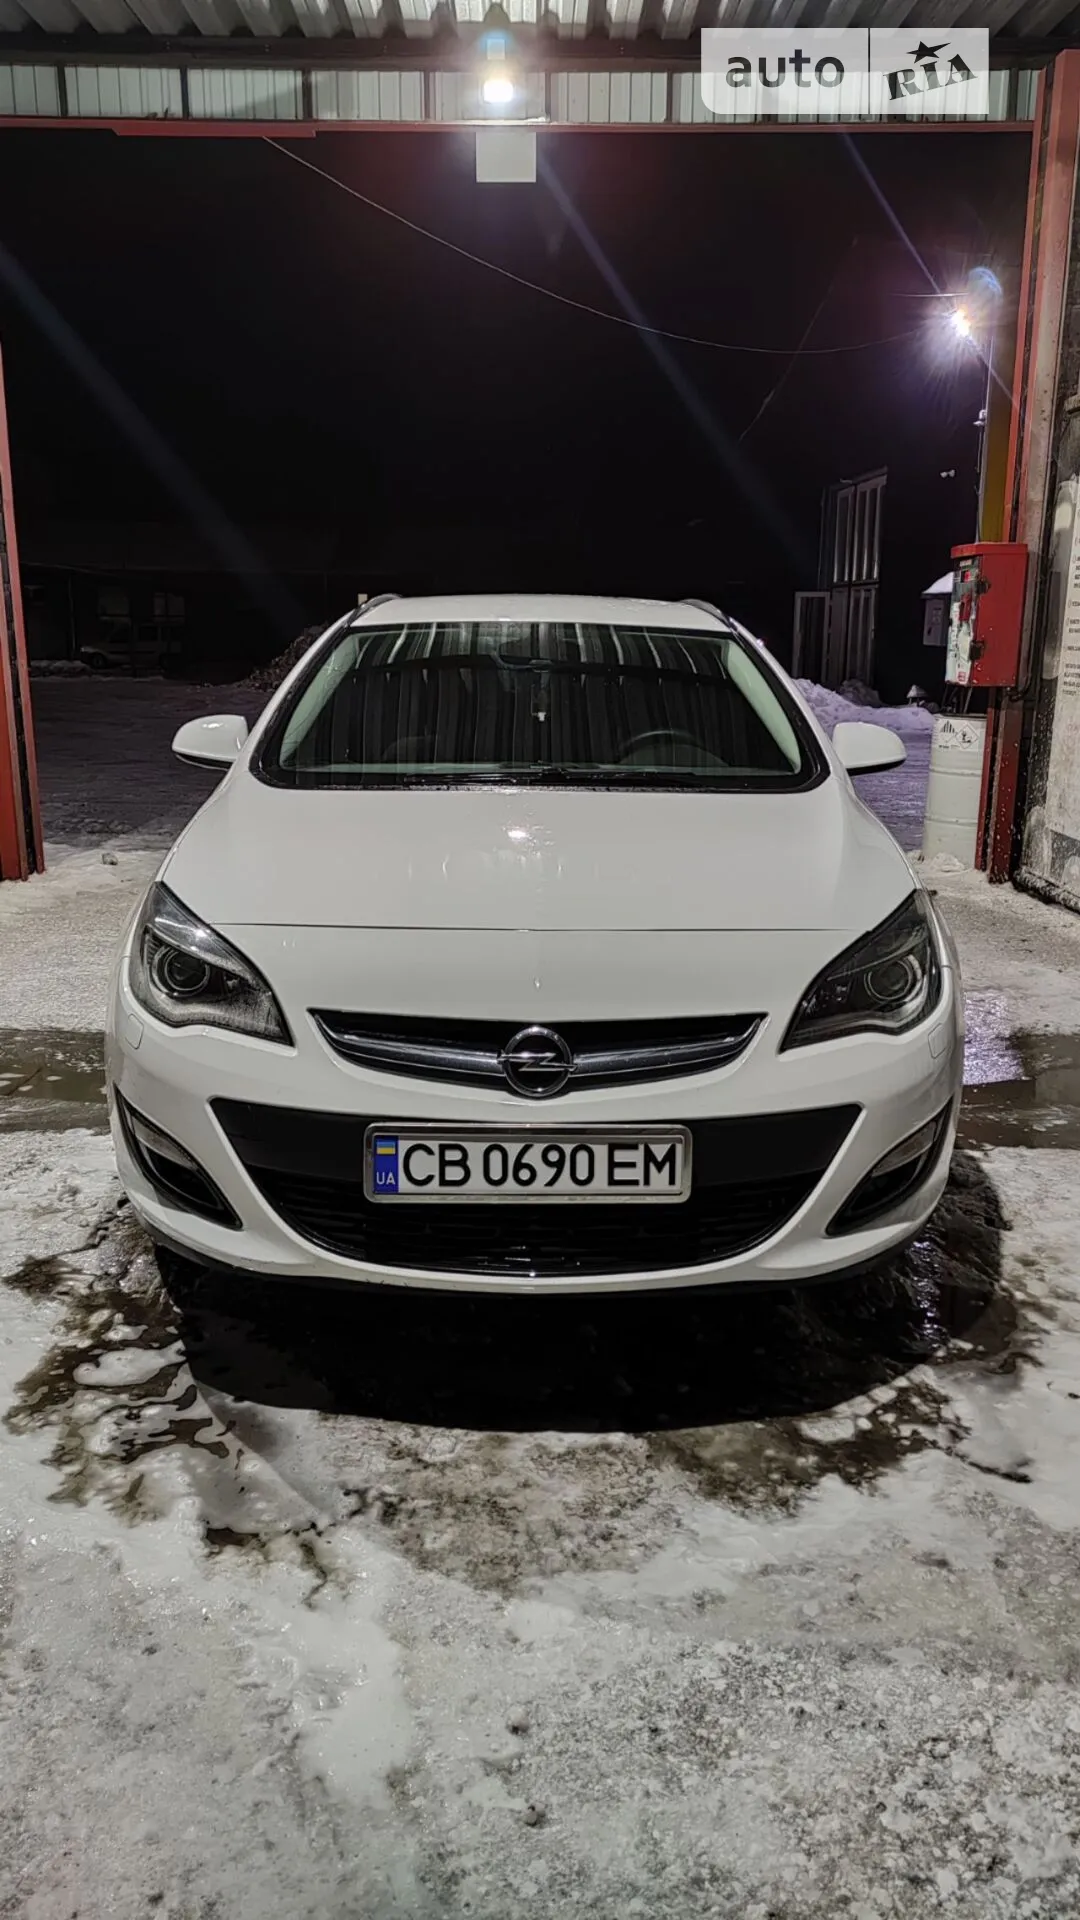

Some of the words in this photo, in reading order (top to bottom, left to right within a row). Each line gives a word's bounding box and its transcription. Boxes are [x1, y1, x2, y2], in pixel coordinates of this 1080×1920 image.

[376, 1172, 396, 1186] UA
[403, 1143, 471, 1187] CB
[482, 1143, 596, 1187] 0690
[607, 1143, 676, 1186] EM
